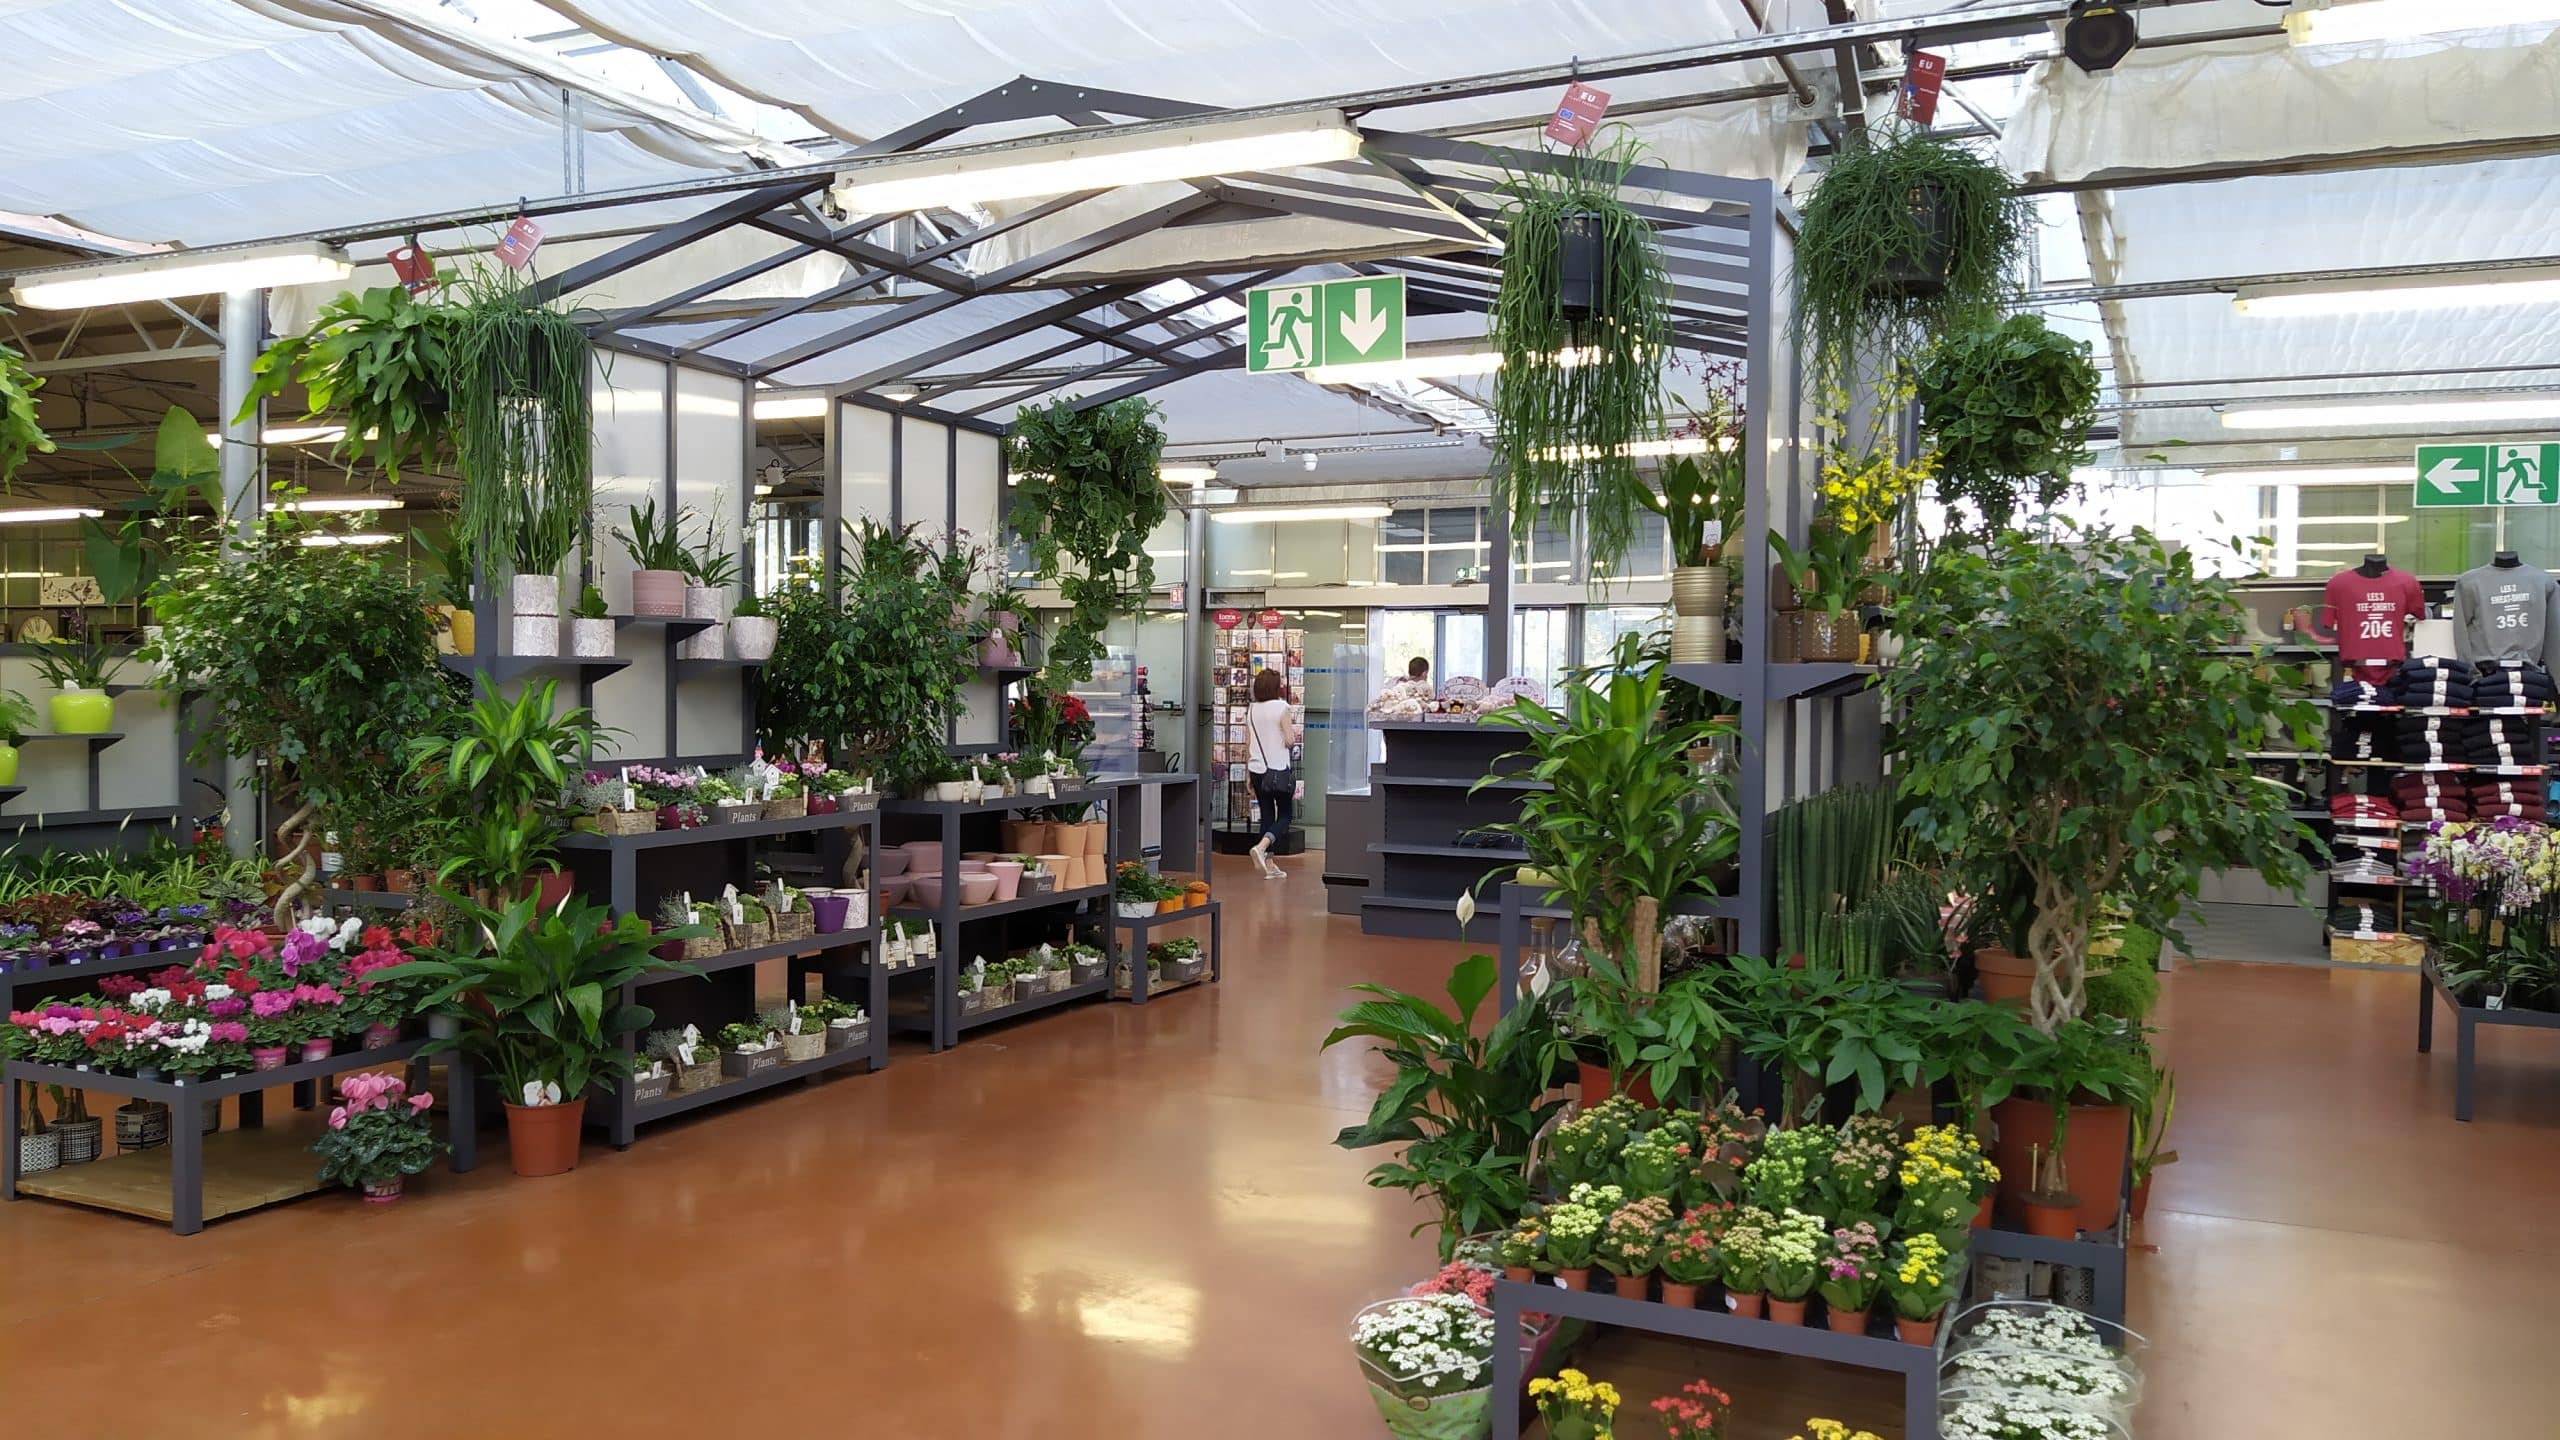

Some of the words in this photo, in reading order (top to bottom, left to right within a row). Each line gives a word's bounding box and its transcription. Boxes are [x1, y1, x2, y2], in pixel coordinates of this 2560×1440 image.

[1919, 59, 1933, 70] EU
[1581, 91, 1596, 103] EU
[2367, 592, 2379, 601] LES
[2496, 612, 2529, 629] 35€
[2360, 620, 2393, 639] 20€
[1060, 782, 1081, 793] Plants
[852, 801, 874, 811] Plants
[732, 811, 757, 824] Plants
[847, 1029, 869, 1043] Plants
[752, 1056, 777, 1071] Plants
[634, 1086, 663, 1101] Plants
